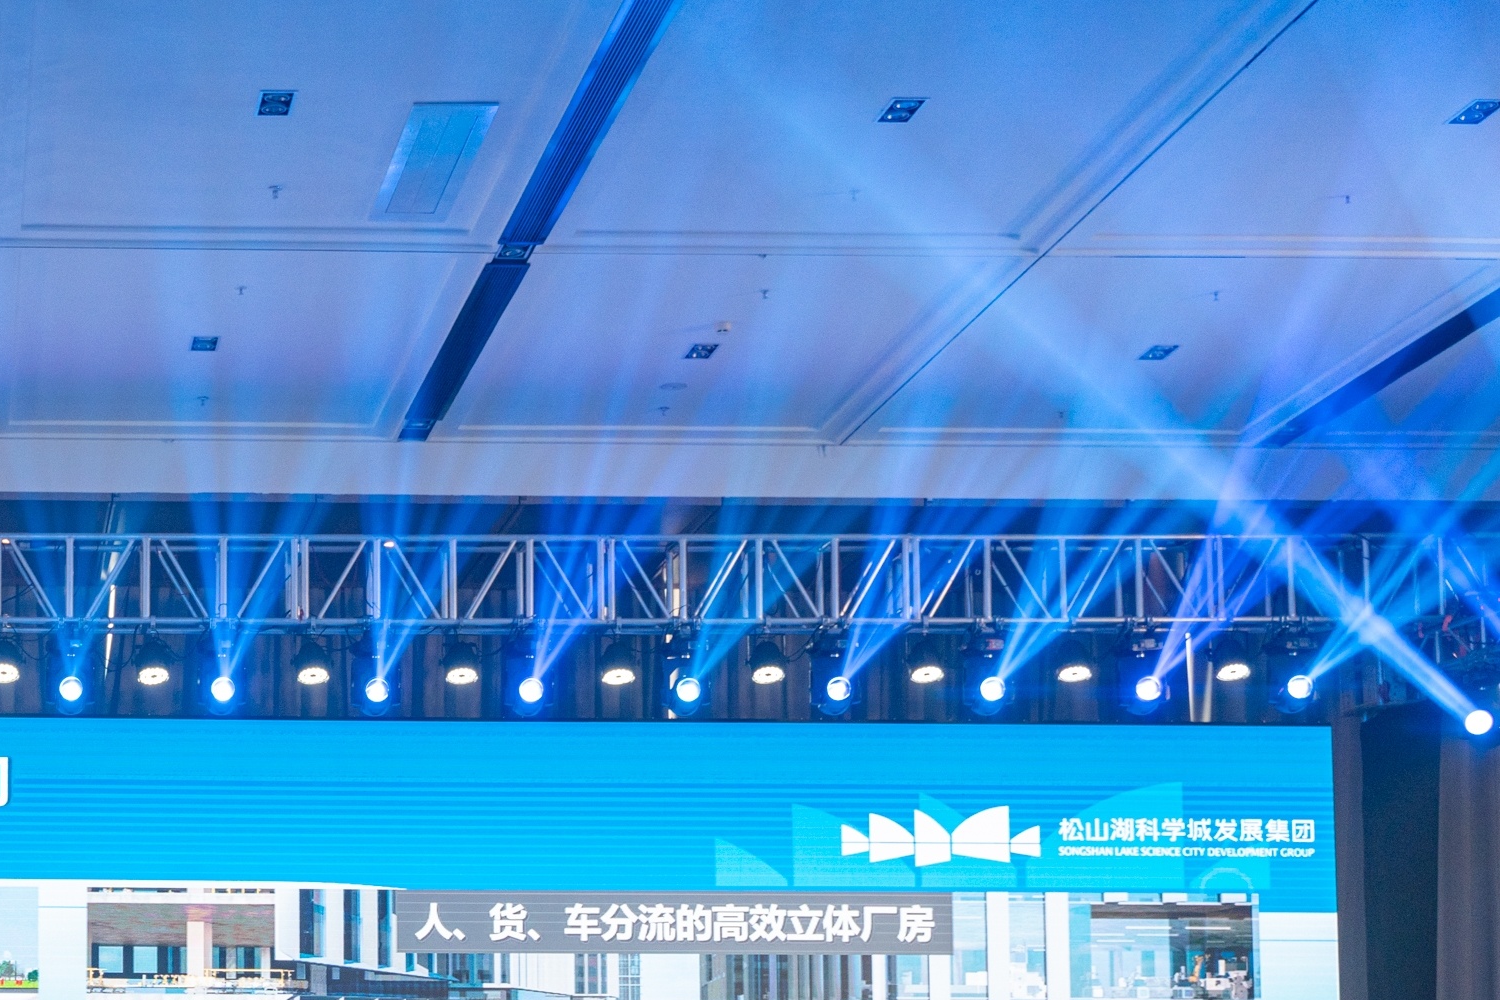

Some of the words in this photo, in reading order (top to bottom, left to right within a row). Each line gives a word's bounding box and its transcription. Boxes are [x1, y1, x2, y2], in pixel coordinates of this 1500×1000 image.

[1058, 817, 1315, 843] 松山湖科学城发展集团
[1058, 846, 1113, 857] SONGSHAN
[1114, 846, 1139, 857] LAKE
[1140, 846, 1181, 857] SCIENCE
[1182, 846, 1205, 857] CITY
[1207, 847, 1278, 858] DEVELOPMENT
[1280, 847, 1315, 858] GROUP
[414, 901, 936, 945] 人、货、车分流的高效立体厂房
